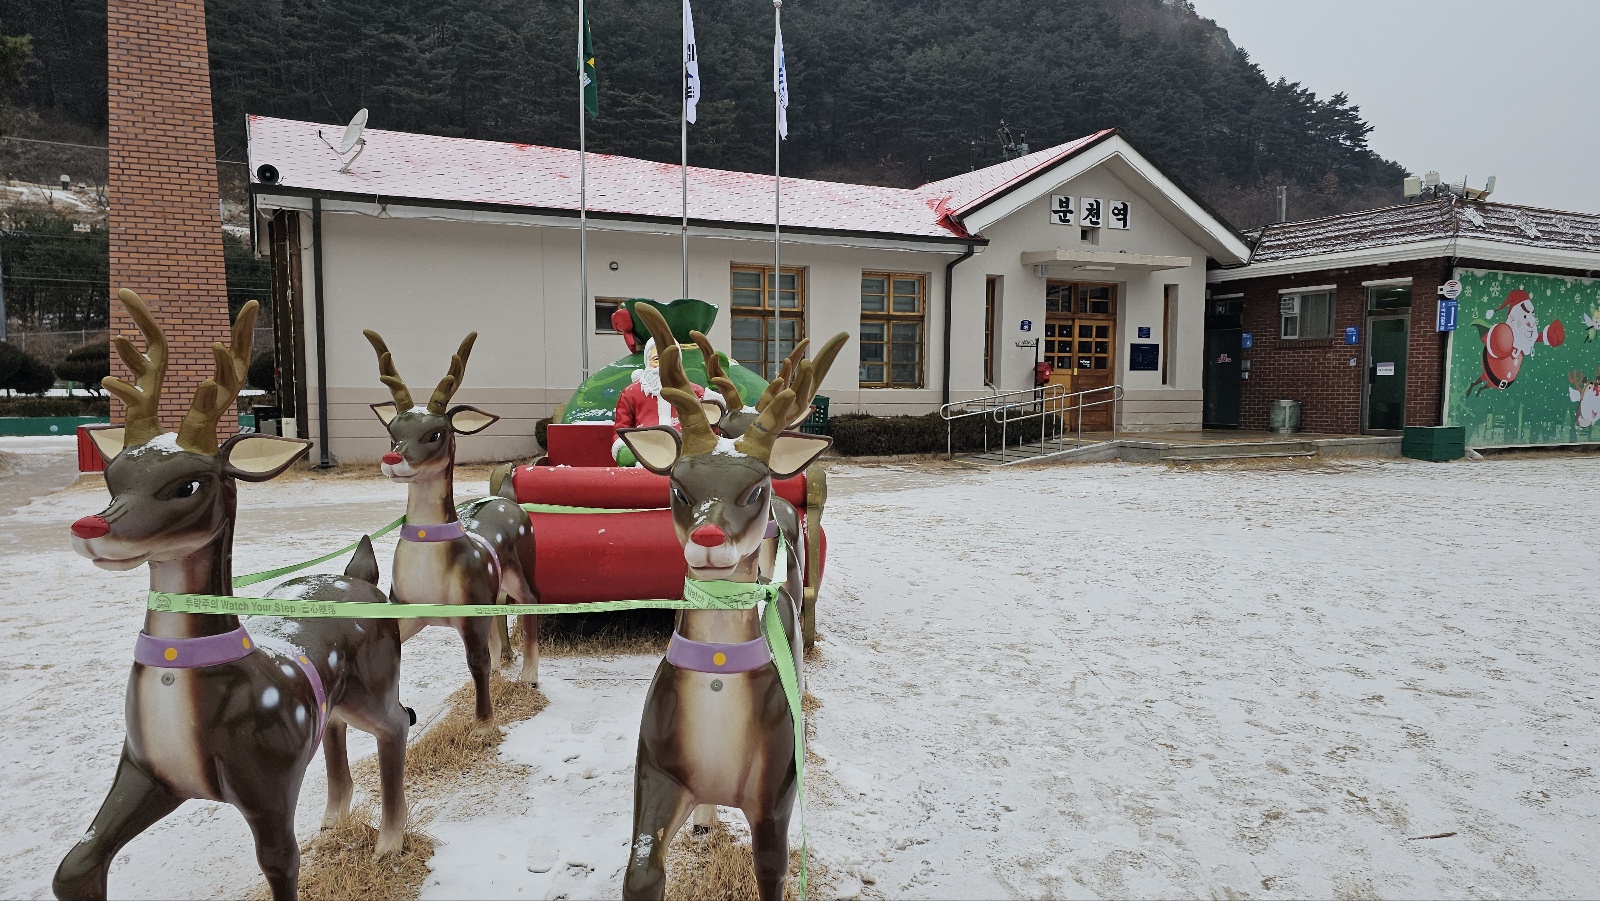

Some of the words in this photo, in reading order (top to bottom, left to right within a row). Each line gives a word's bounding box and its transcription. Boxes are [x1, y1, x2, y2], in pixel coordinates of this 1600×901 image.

[1052, 196, 1129, 229] 분천역
[185, 597, 219, 610] 추락주의
[220, 599, 249, 611] Watch
[250, 601, 272, 612] Your
[273, 602, 296, 613] Step
[688, 585, 705, 605] Watch
[706, 598, 723, 610] Yo
